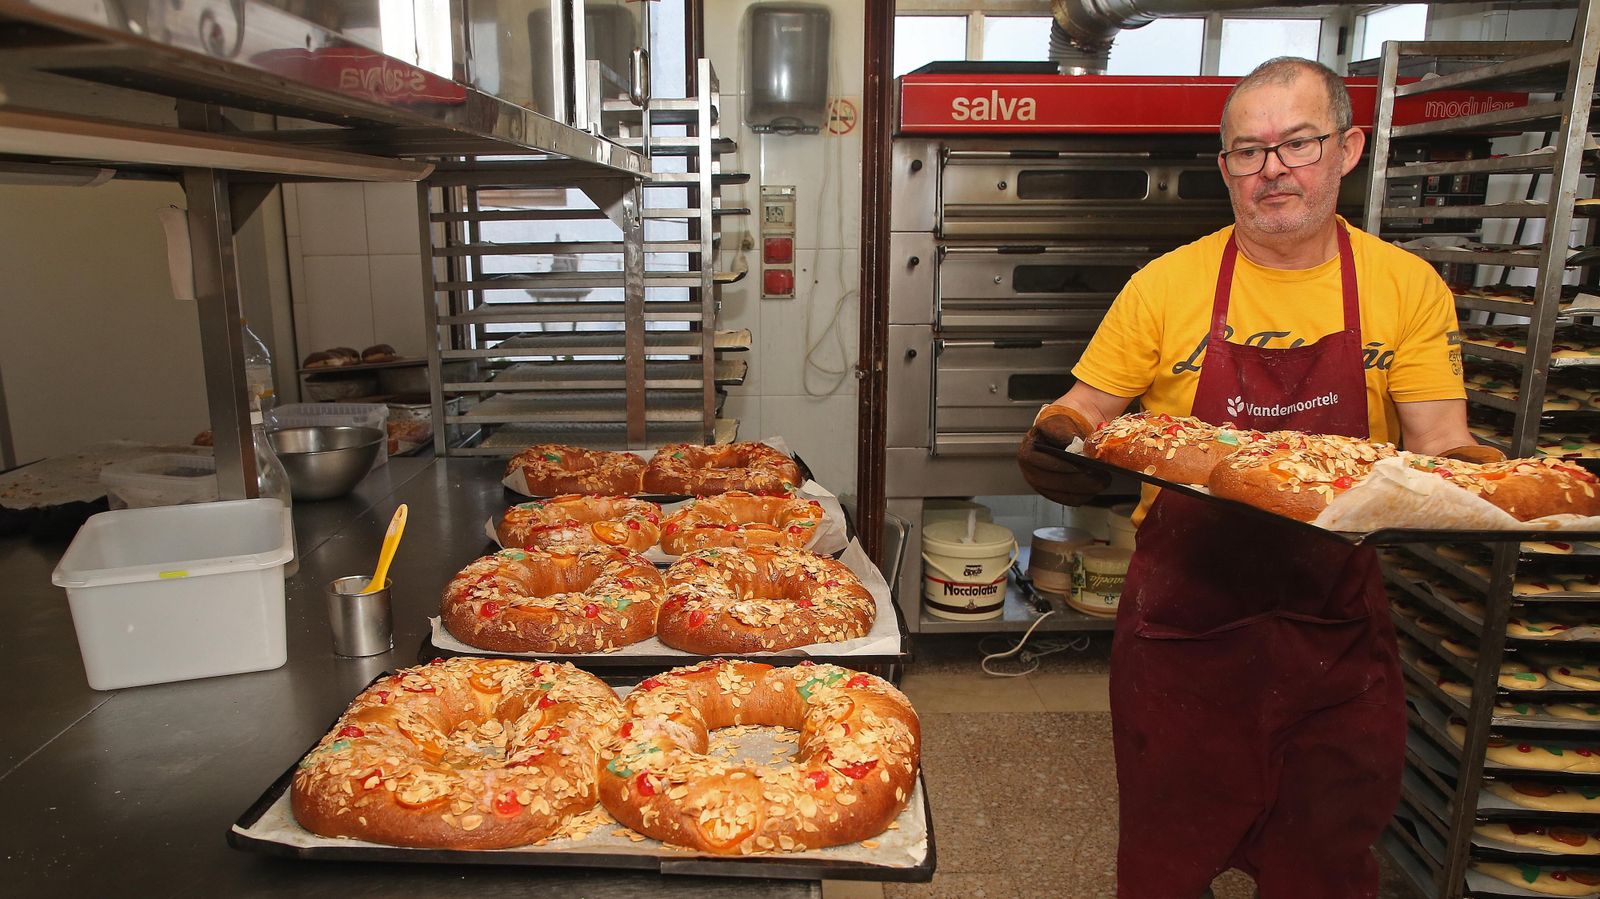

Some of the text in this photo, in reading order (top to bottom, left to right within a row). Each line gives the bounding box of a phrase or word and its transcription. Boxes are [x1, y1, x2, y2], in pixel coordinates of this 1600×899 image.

[951, 89, 1036, 121] salva
[1425, 96, 1515, 118] modular
[1246, 391, 1339, 417] Vandemoortele
